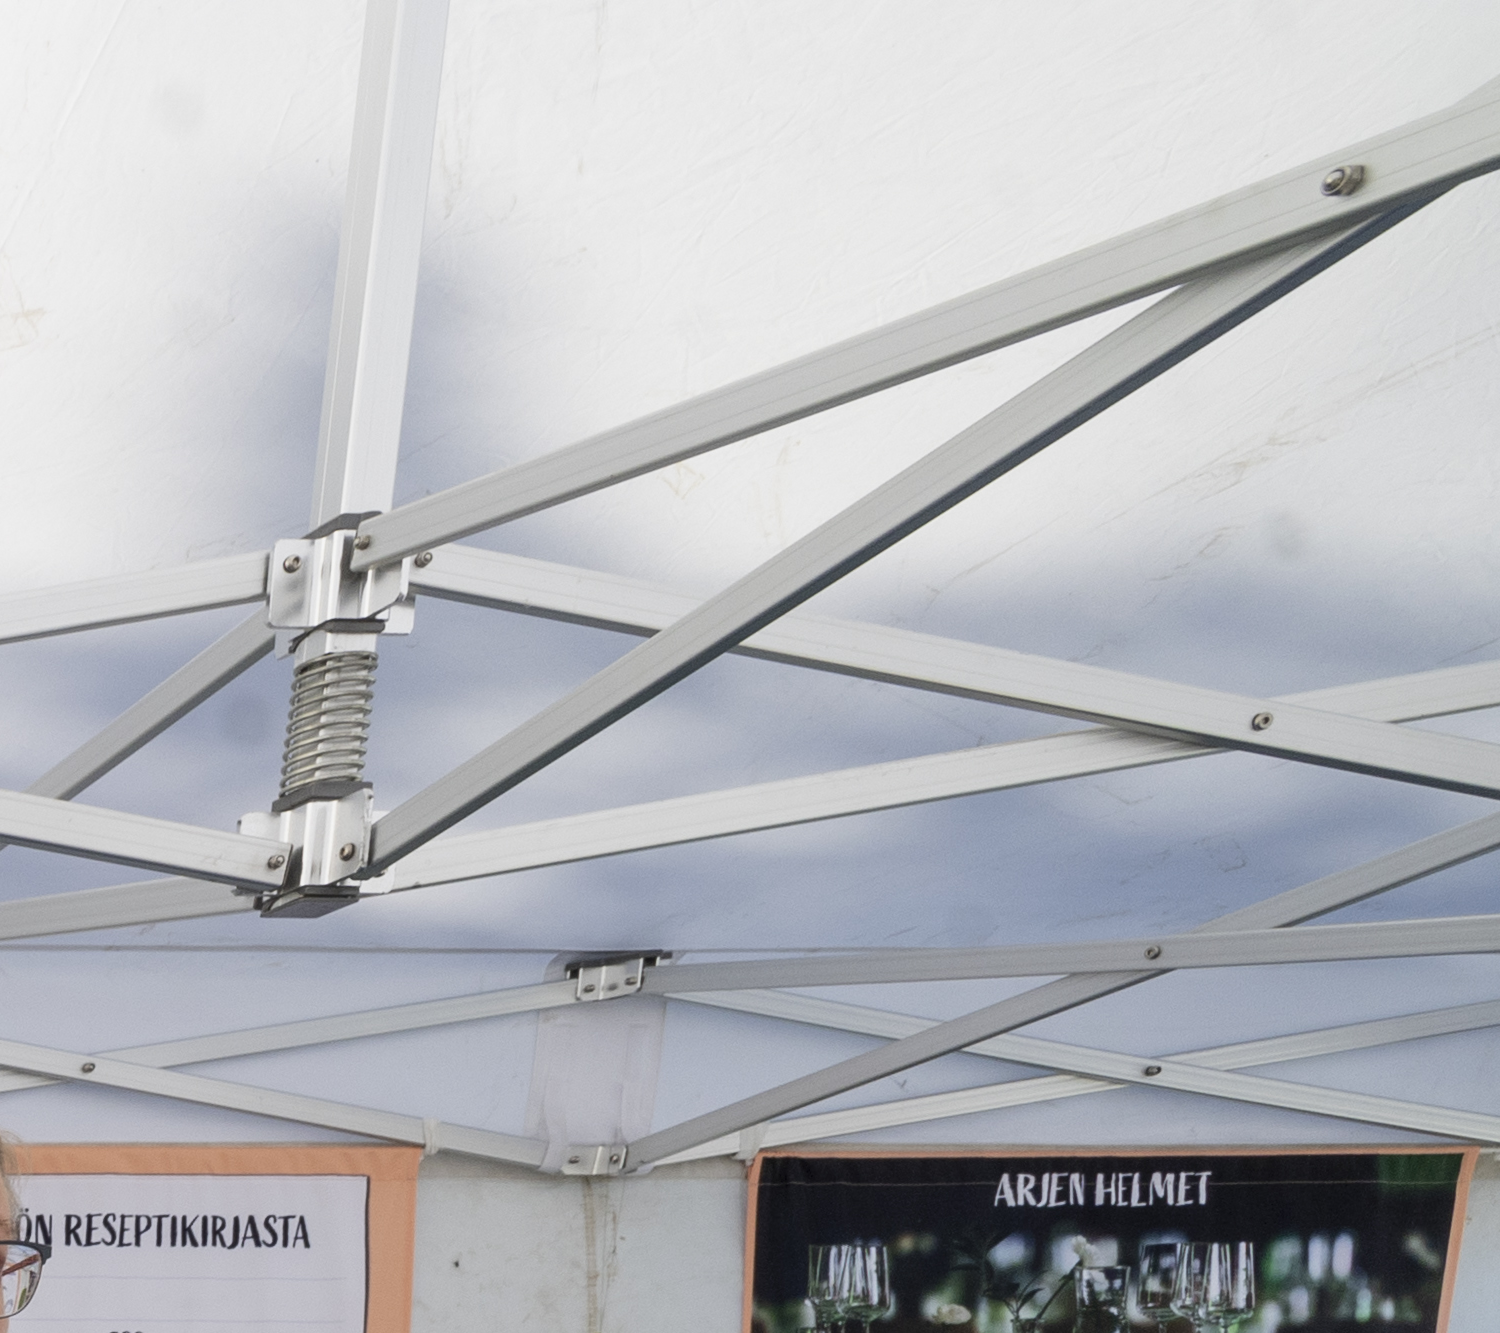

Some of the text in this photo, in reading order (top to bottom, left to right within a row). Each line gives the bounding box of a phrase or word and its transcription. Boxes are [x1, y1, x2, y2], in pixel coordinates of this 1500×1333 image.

[993, 1170, 1212, 1208] ARJEN HELMET
[64, 1212, 311, 1250] RESEPTIKIRJASTA
